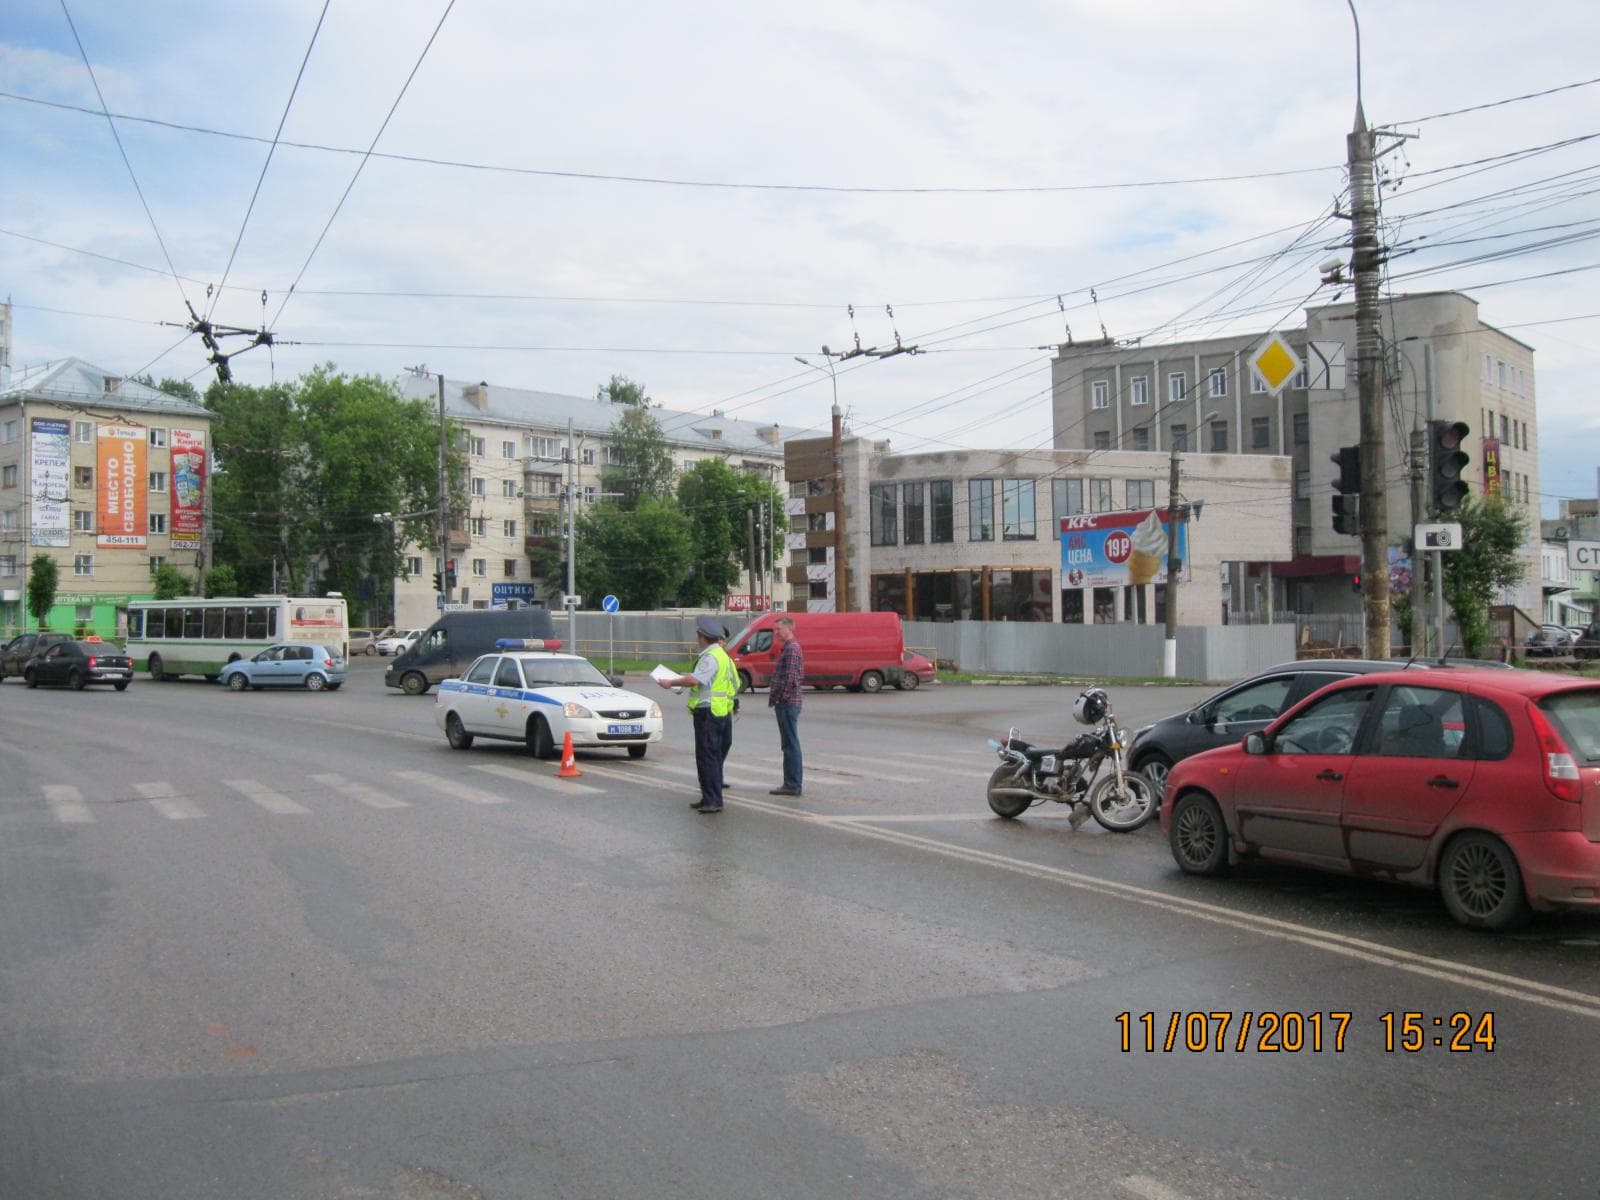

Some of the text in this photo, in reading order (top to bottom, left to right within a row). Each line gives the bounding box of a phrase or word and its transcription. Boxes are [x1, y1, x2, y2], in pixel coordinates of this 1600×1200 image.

[174, 430, 192, 439] Мир
[177, 438, 203, 448] Книги
[34, 458, 67, 467] КРЕПЕЖ
[107, 458, 119, 514] МЕСТО
[124, 441, 136, 532] СВОБОДНО
[1068, 516, 1097, 529] KFC
[106, 536, 139, 544] 454-111
[1067, 549, 1093, 565] ЦЕНА
[494, 586, 534, 594] ОПТИКА
